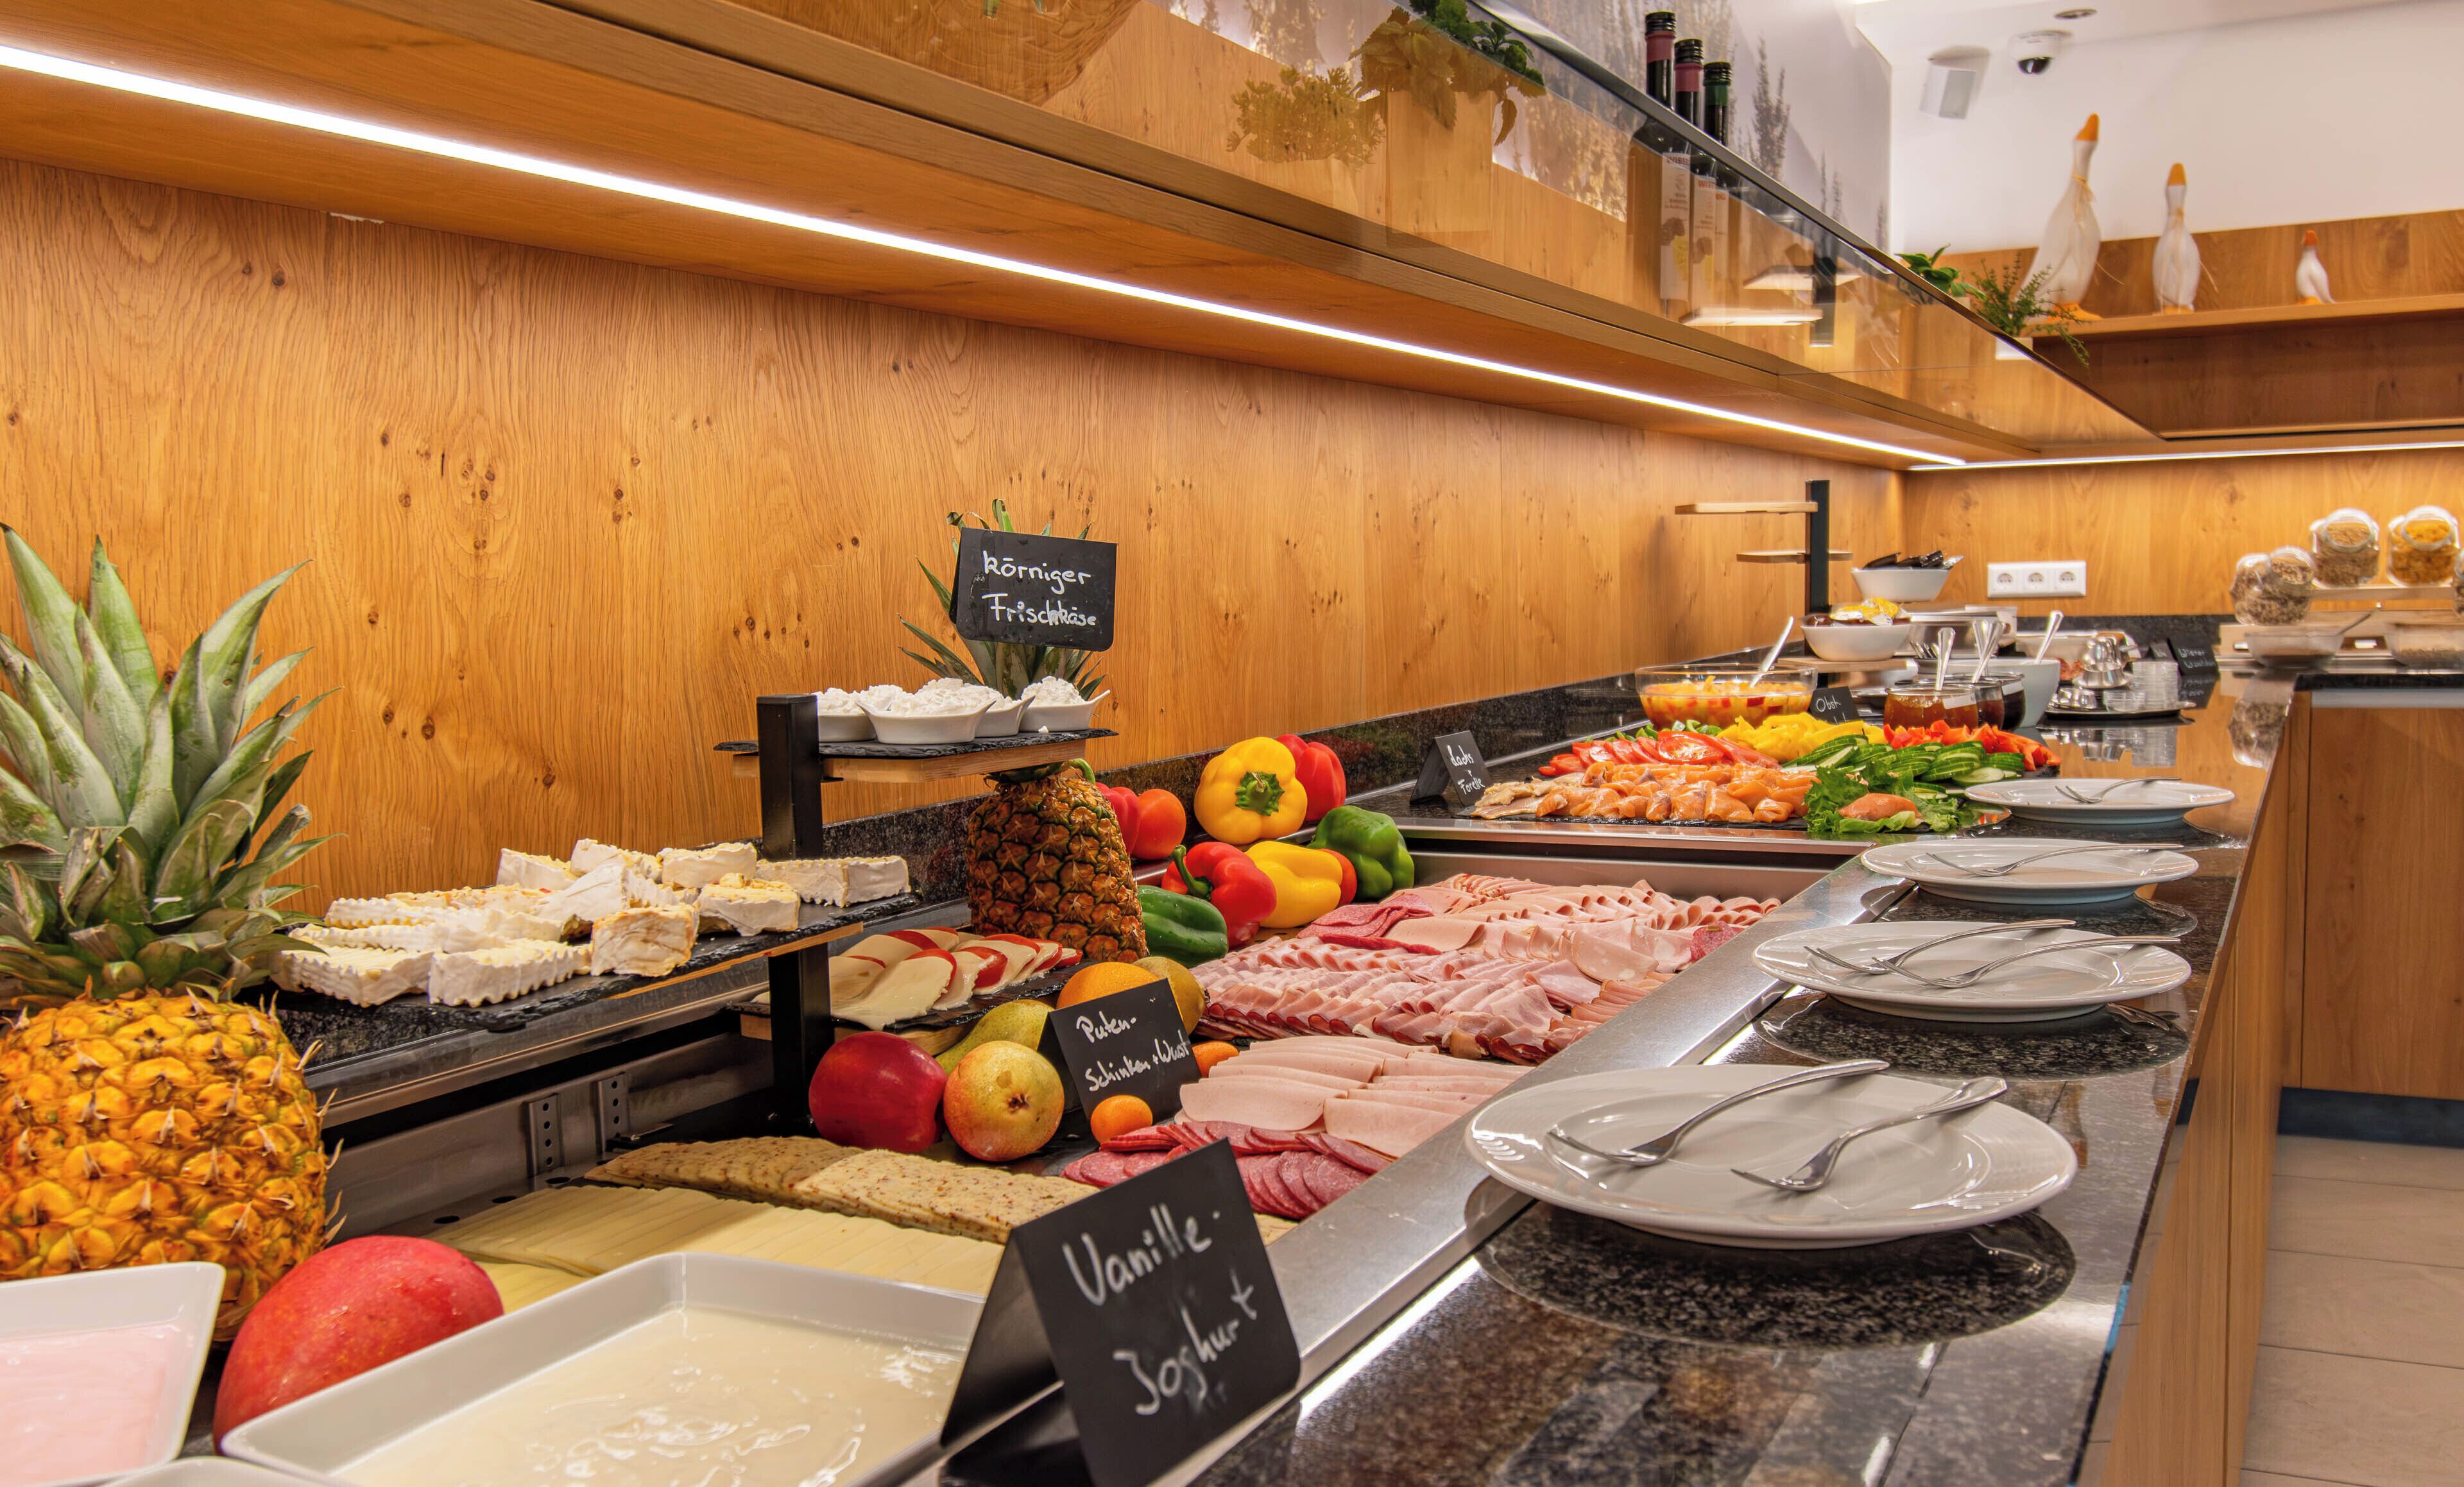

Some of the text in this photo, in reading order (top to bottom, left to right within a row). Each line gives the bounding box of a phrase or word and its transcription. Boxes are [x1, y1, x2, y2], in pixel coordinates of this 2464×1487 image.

[981, 592, 1097, 626] Frischkäse
[1457, 777, 1486, 795] Forelle
[1113, 1269, 1257, 1415] Joghurt
